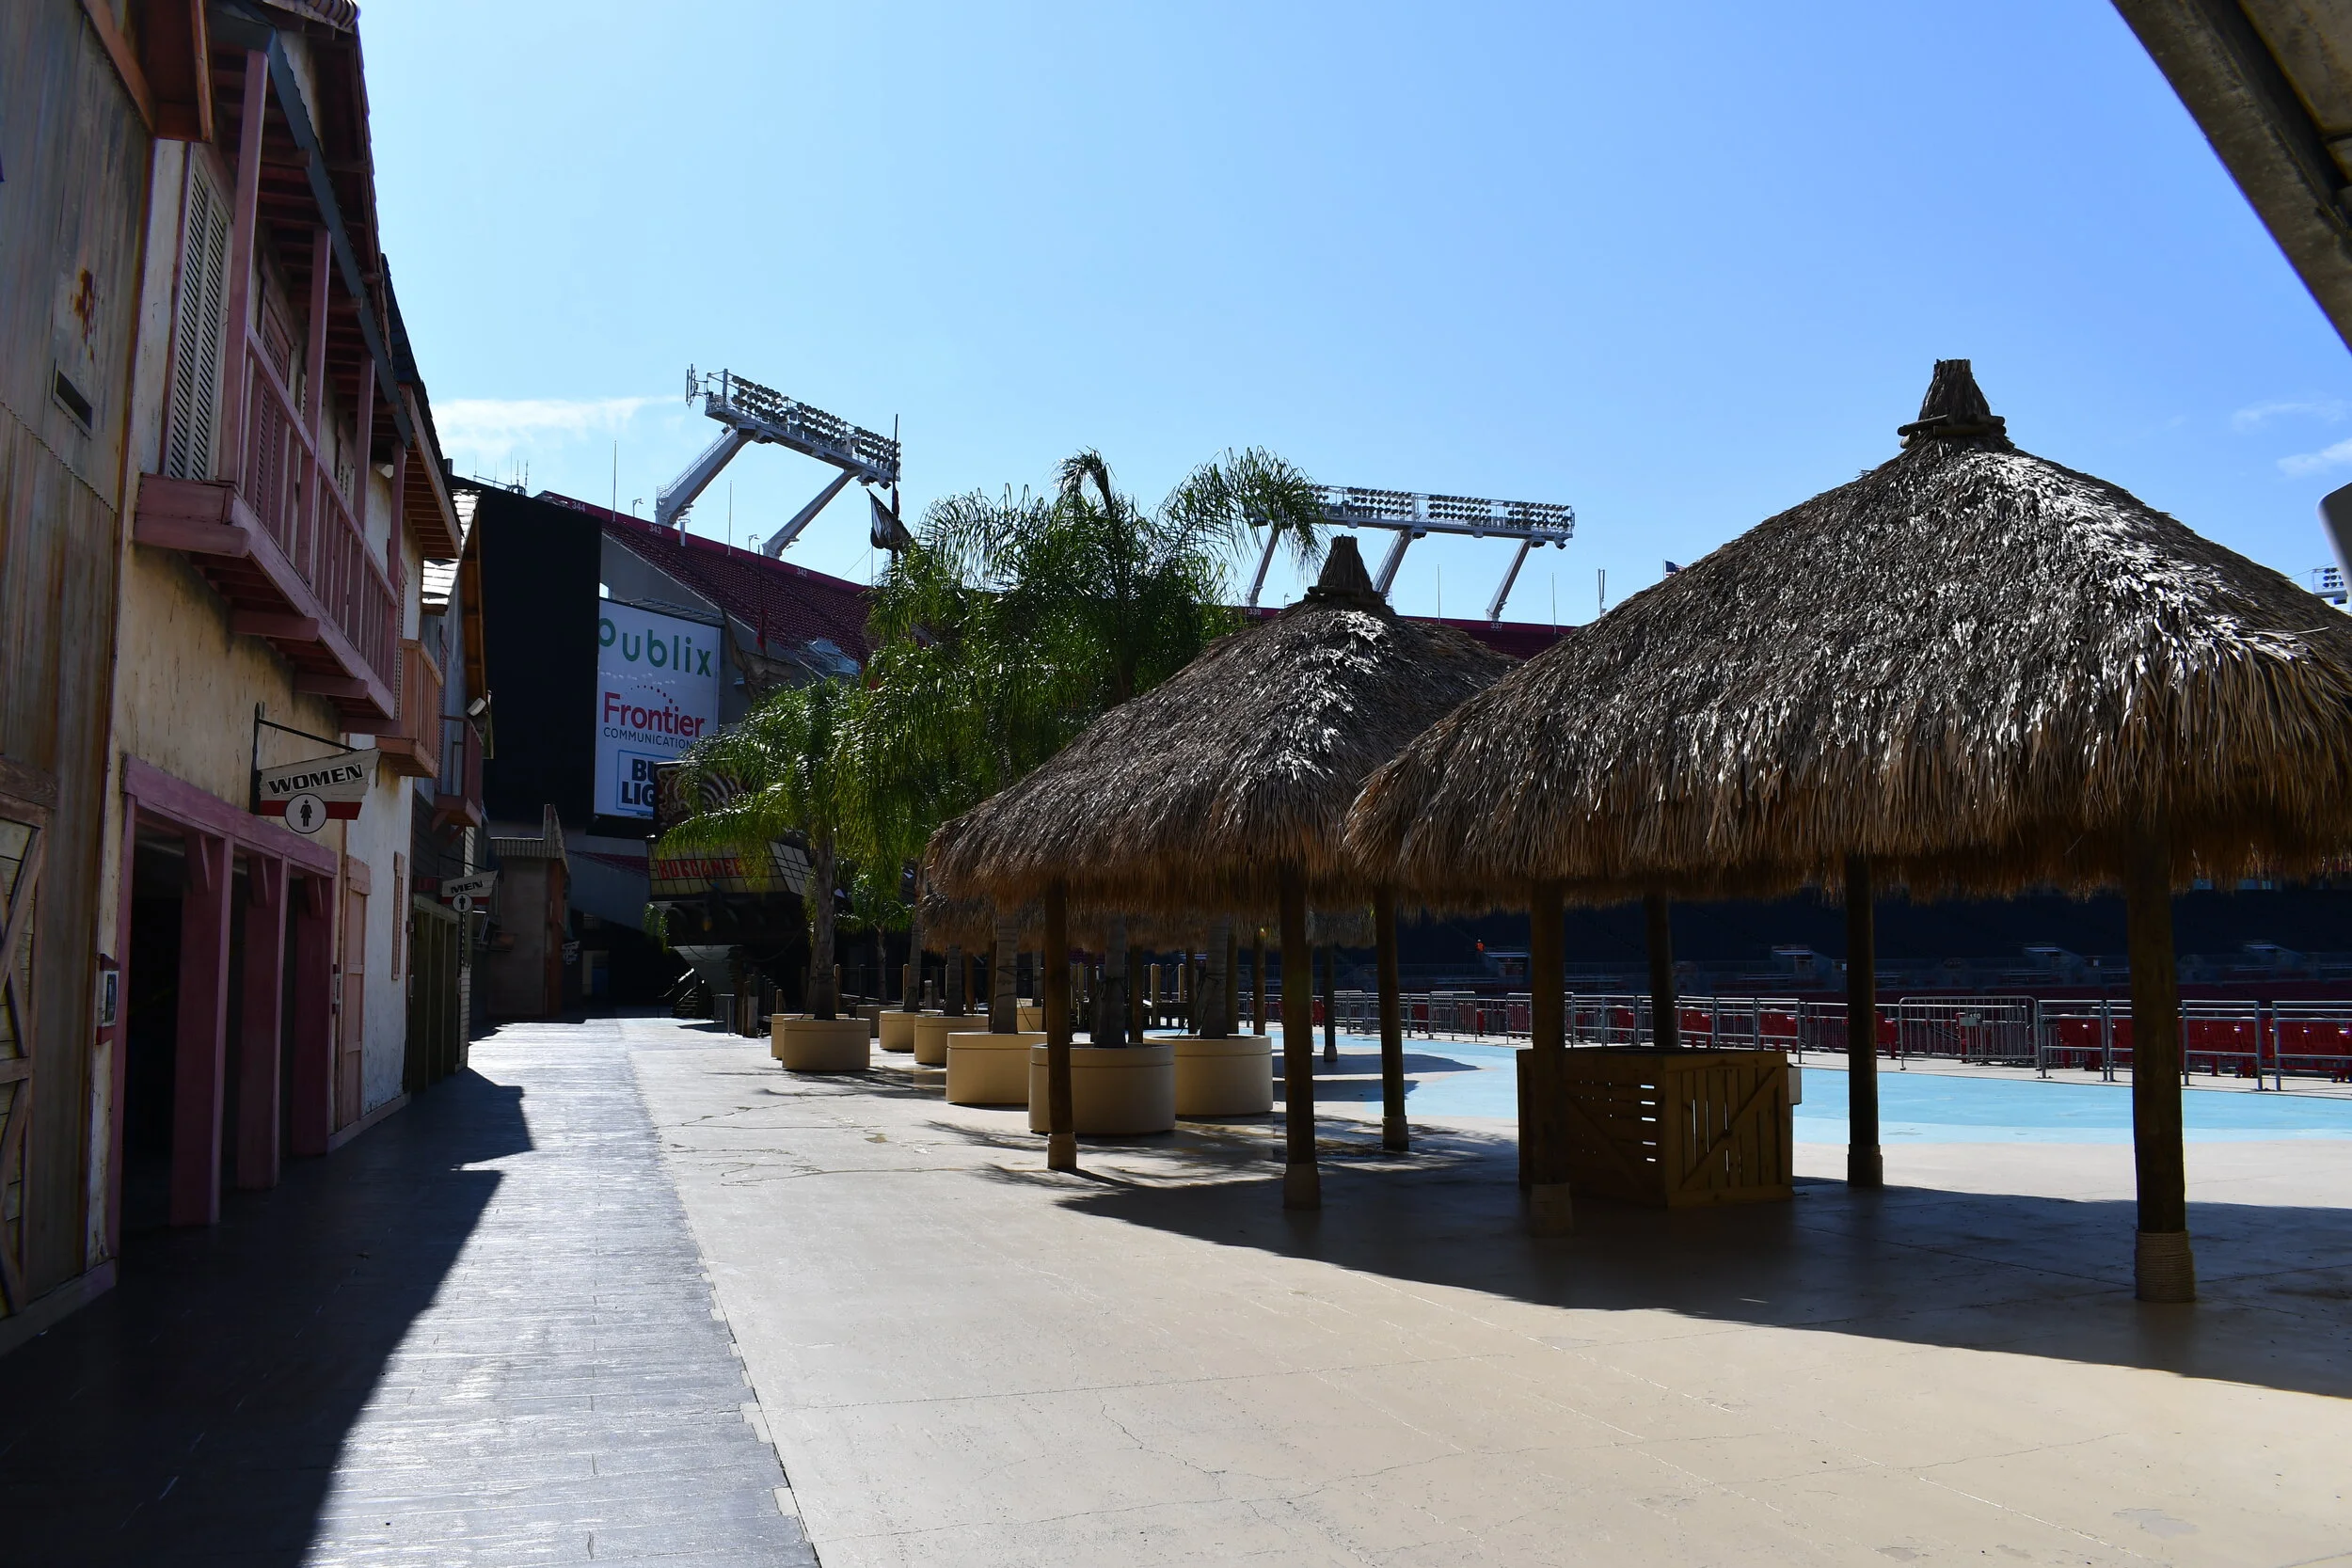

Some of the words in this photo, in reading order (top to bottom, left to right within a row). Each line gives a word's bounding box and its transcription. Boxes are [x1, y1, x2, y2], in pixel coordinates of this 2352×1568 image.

[604, 691, 706, 738] Frontier
[603, 726, 694, 750] COMMUNICATION
[267, 763, 363, 795] WOMEN
[621, 781, 656, 807] LIG
[451, 879, 484, 895] MEN
